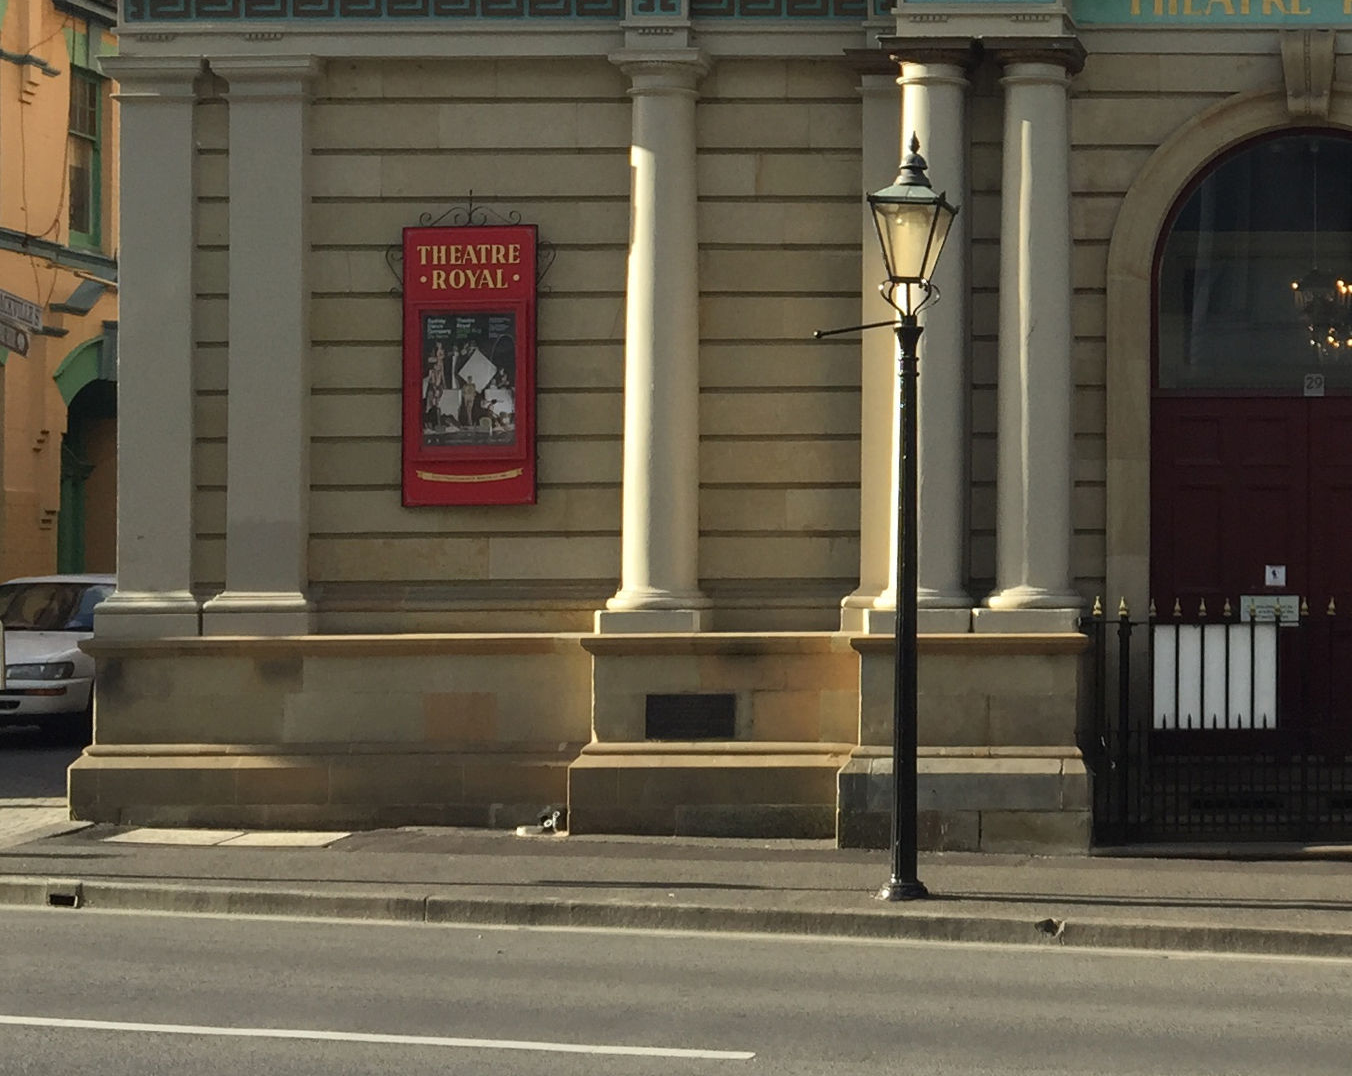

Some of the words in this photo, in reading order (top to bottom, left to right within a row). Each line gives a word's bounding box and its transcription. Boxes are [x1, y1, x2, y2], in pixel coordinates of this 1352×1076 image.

[417, 244, 520, 266] THEATRE
[432, 269, 508, 290] ROYAL
[1306, 376, 1323, 390] 29
